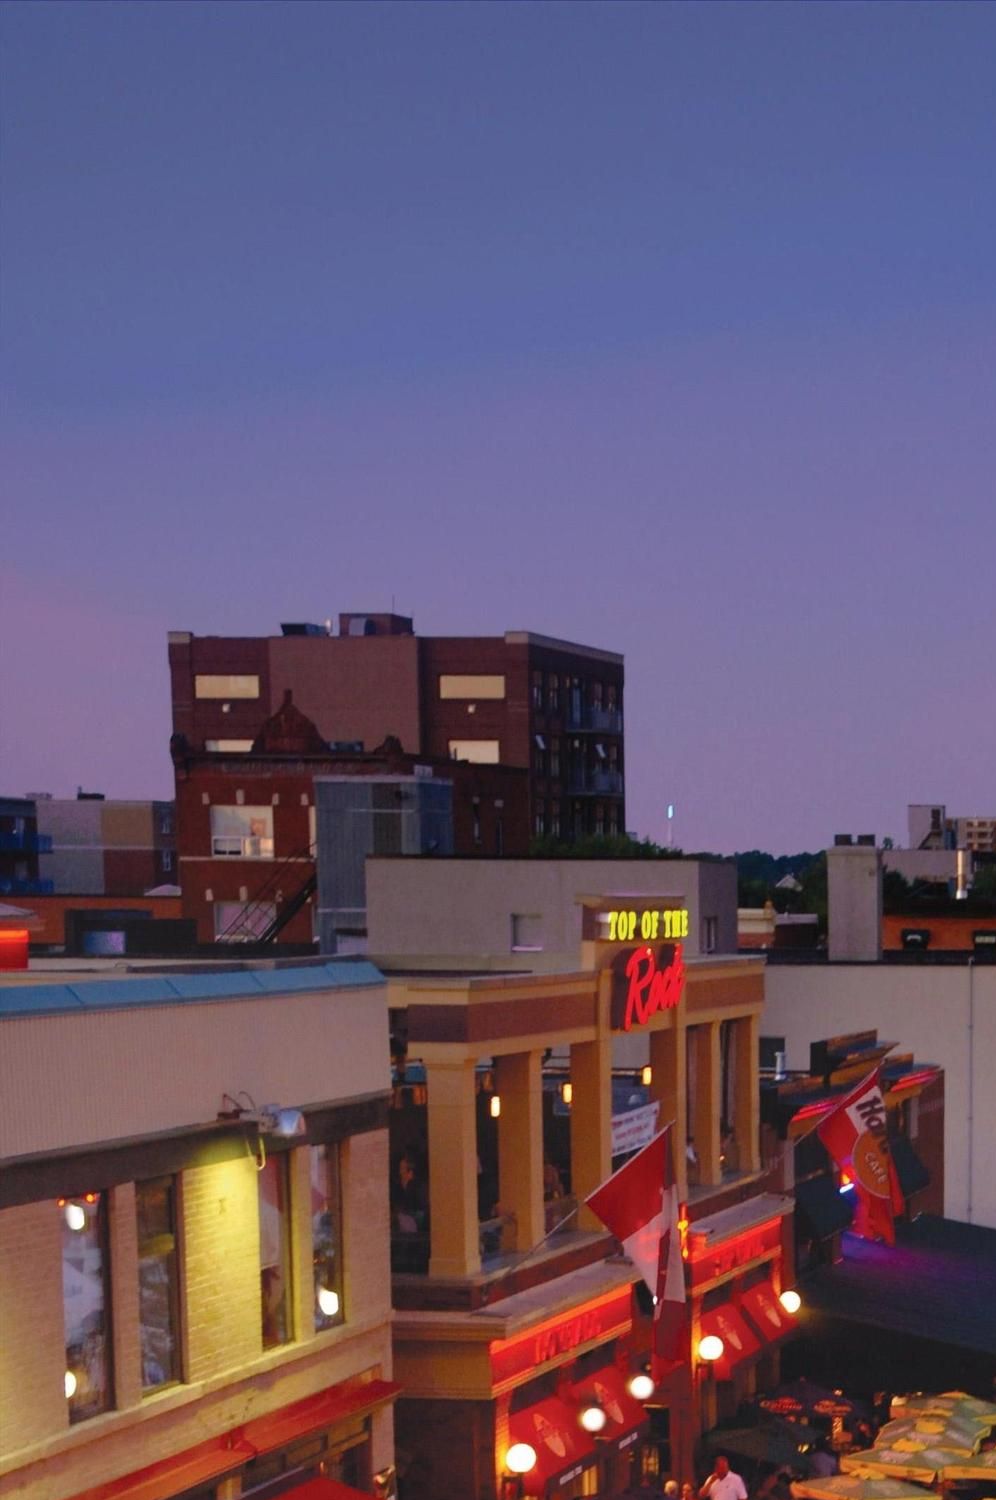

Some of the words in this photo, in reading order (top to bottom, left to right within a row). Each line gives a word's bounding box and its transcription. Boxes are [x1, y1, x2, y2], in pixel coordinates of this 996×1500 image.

[608, 911, 637, 940] TOP
[641, 910, 659, 939] OF
[663, 909, 688, 938] THE
